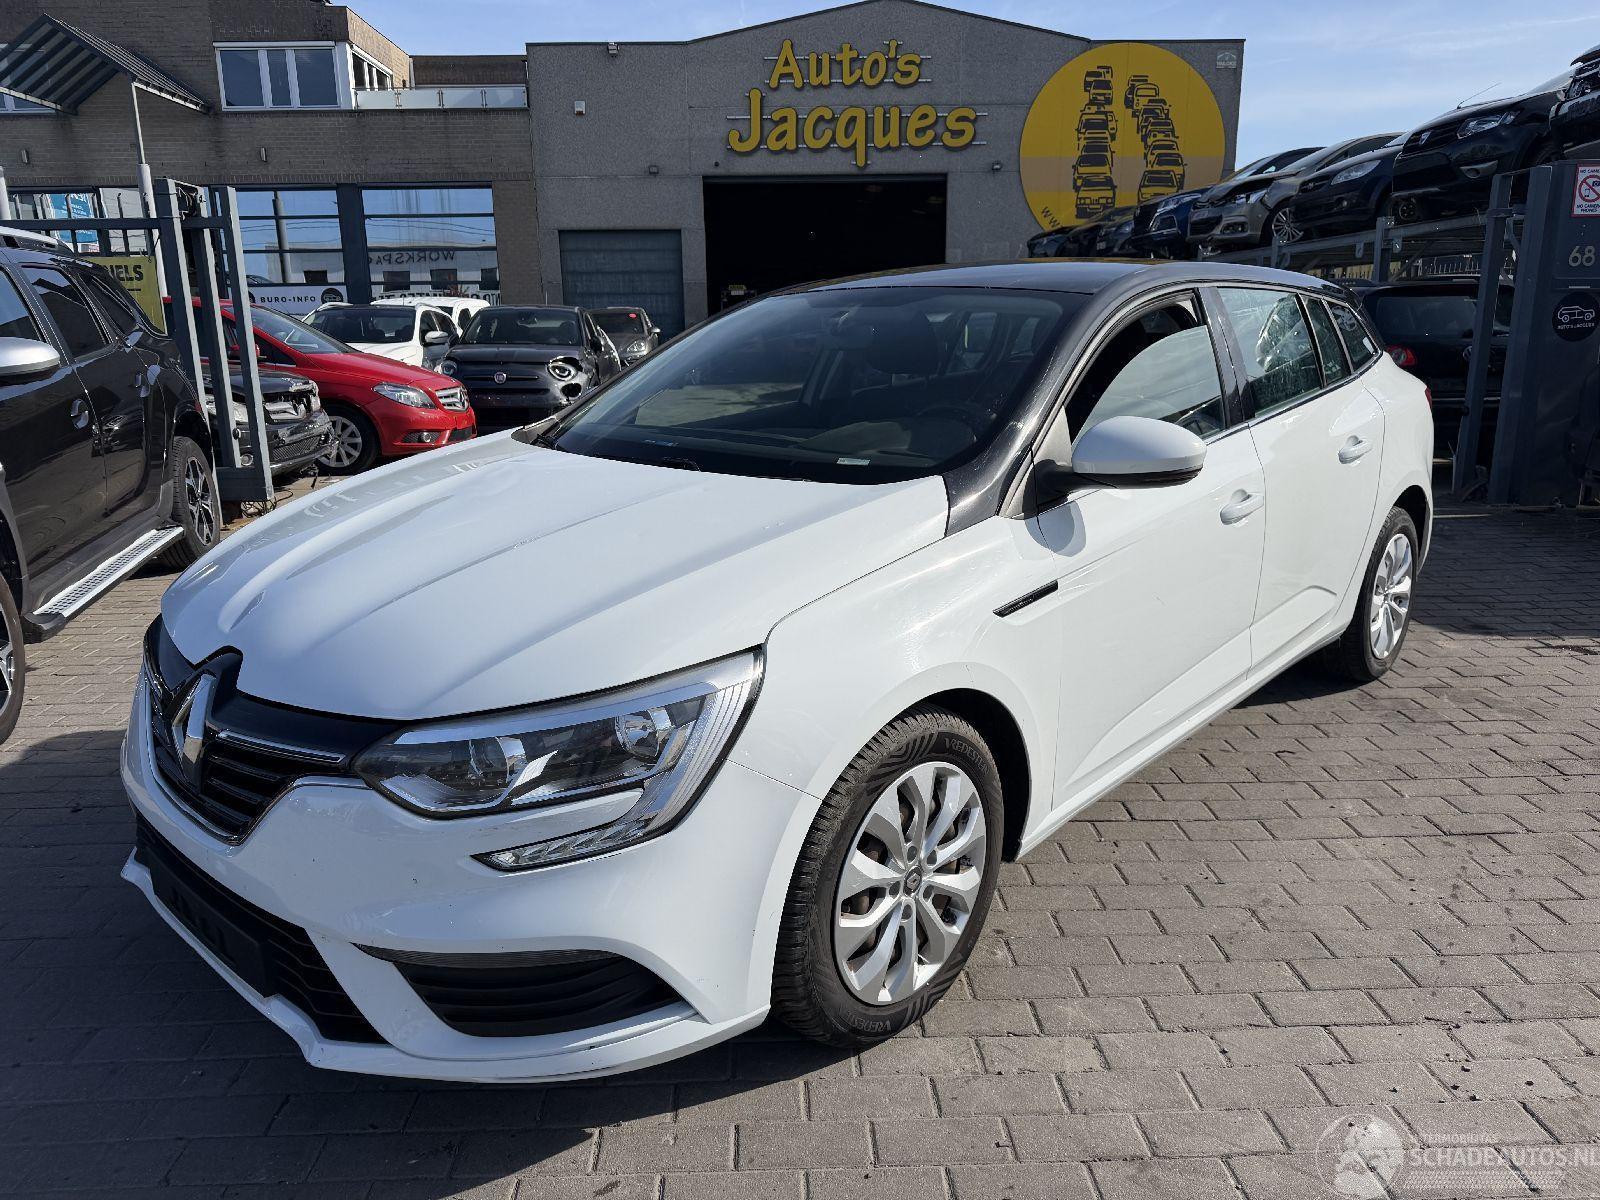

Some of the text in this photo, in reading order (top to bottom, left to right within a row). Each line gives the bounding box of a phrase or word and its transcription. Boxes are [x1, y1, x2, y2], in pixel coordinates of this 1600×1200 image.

[768, 38, 922, 89] Auto's
[728, 88, 977, 168] Jacques
[1568, 245, 1595, 267] 68
[260, 295, 316, 303] BURO-INFO
